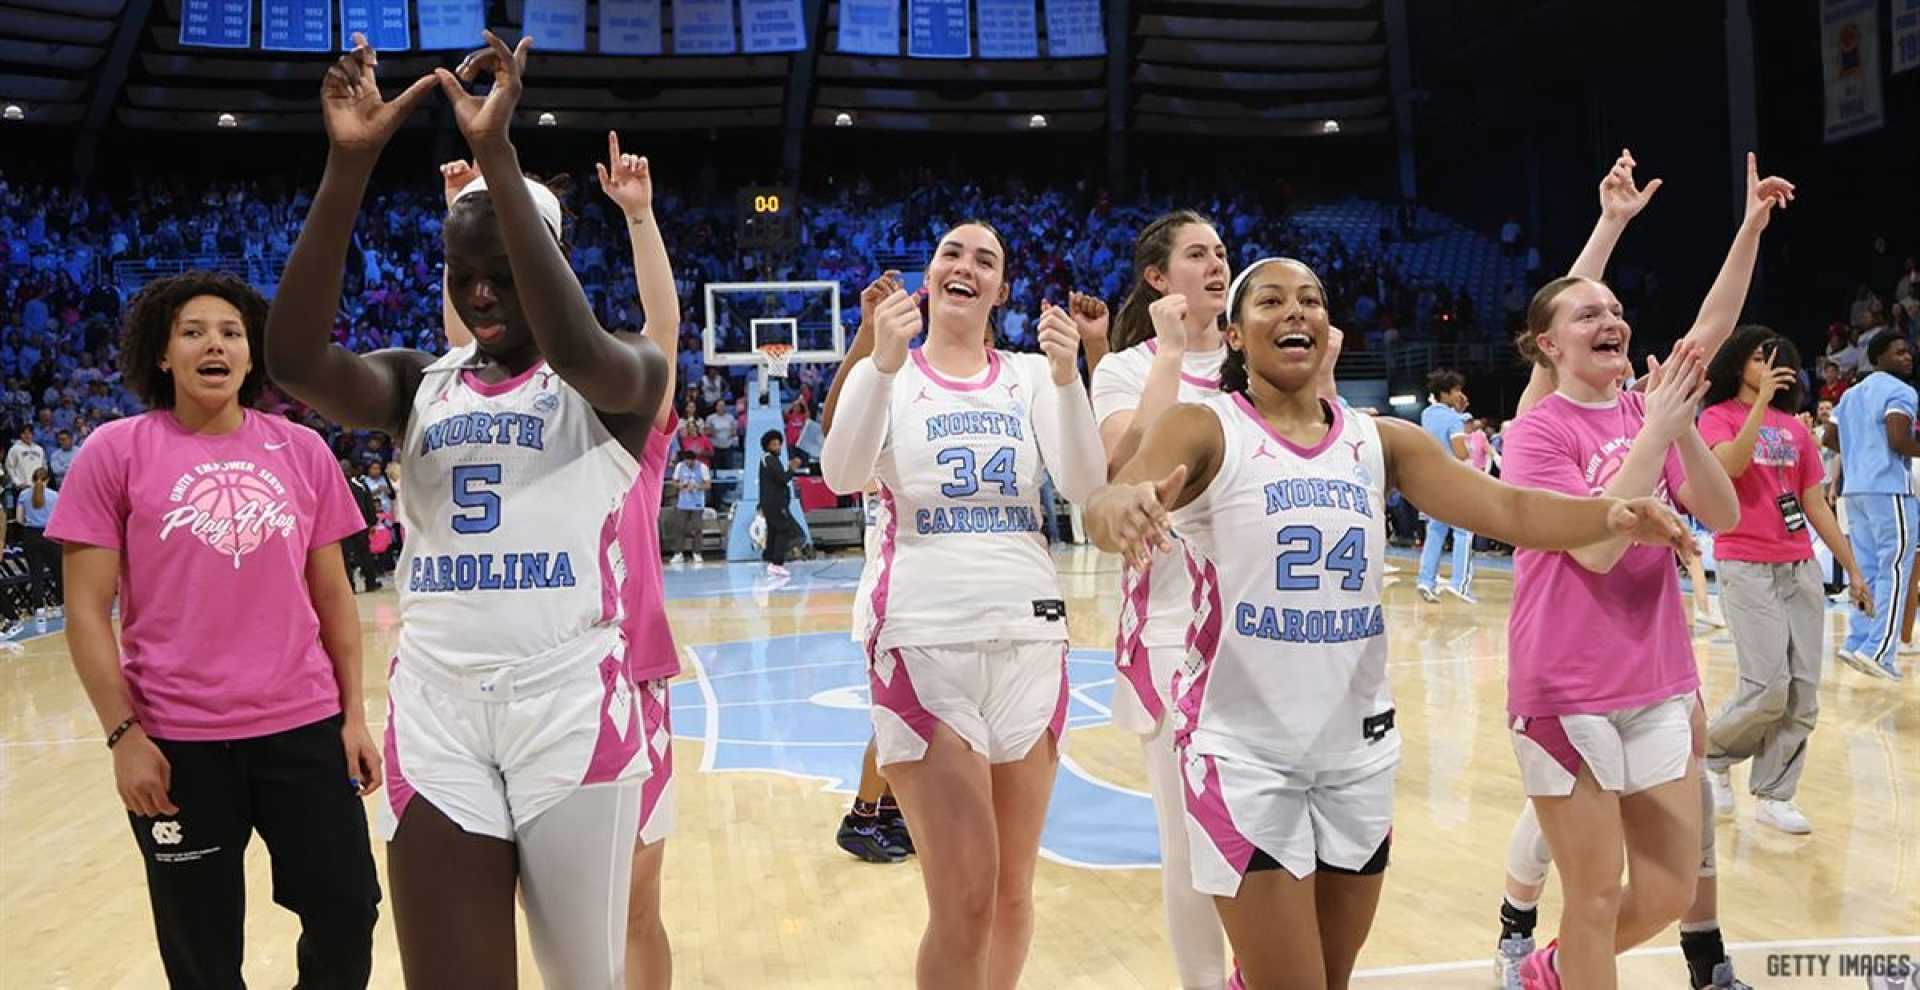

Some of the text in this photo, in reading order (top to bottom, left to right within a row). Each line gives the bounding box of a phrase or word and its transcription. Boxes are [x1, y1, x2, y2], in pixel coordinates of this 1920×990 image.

[422, 411, 545, 458] NORTH
[926, 410, 1024, 442] NORTH
[936, 446, 1019, 498] 34
[450, 463, 502, 535] 5
[915, 505, 1041, 534] CAROLINA
[1264, 478, 1373, 519] NORTH
[161, 505, 231, 544] Play
[410, 551, 577, 593] CAROLINA
[1276, 524, 1368, 591] 24
[1235, 602, 1385, 644] CAROLINA
